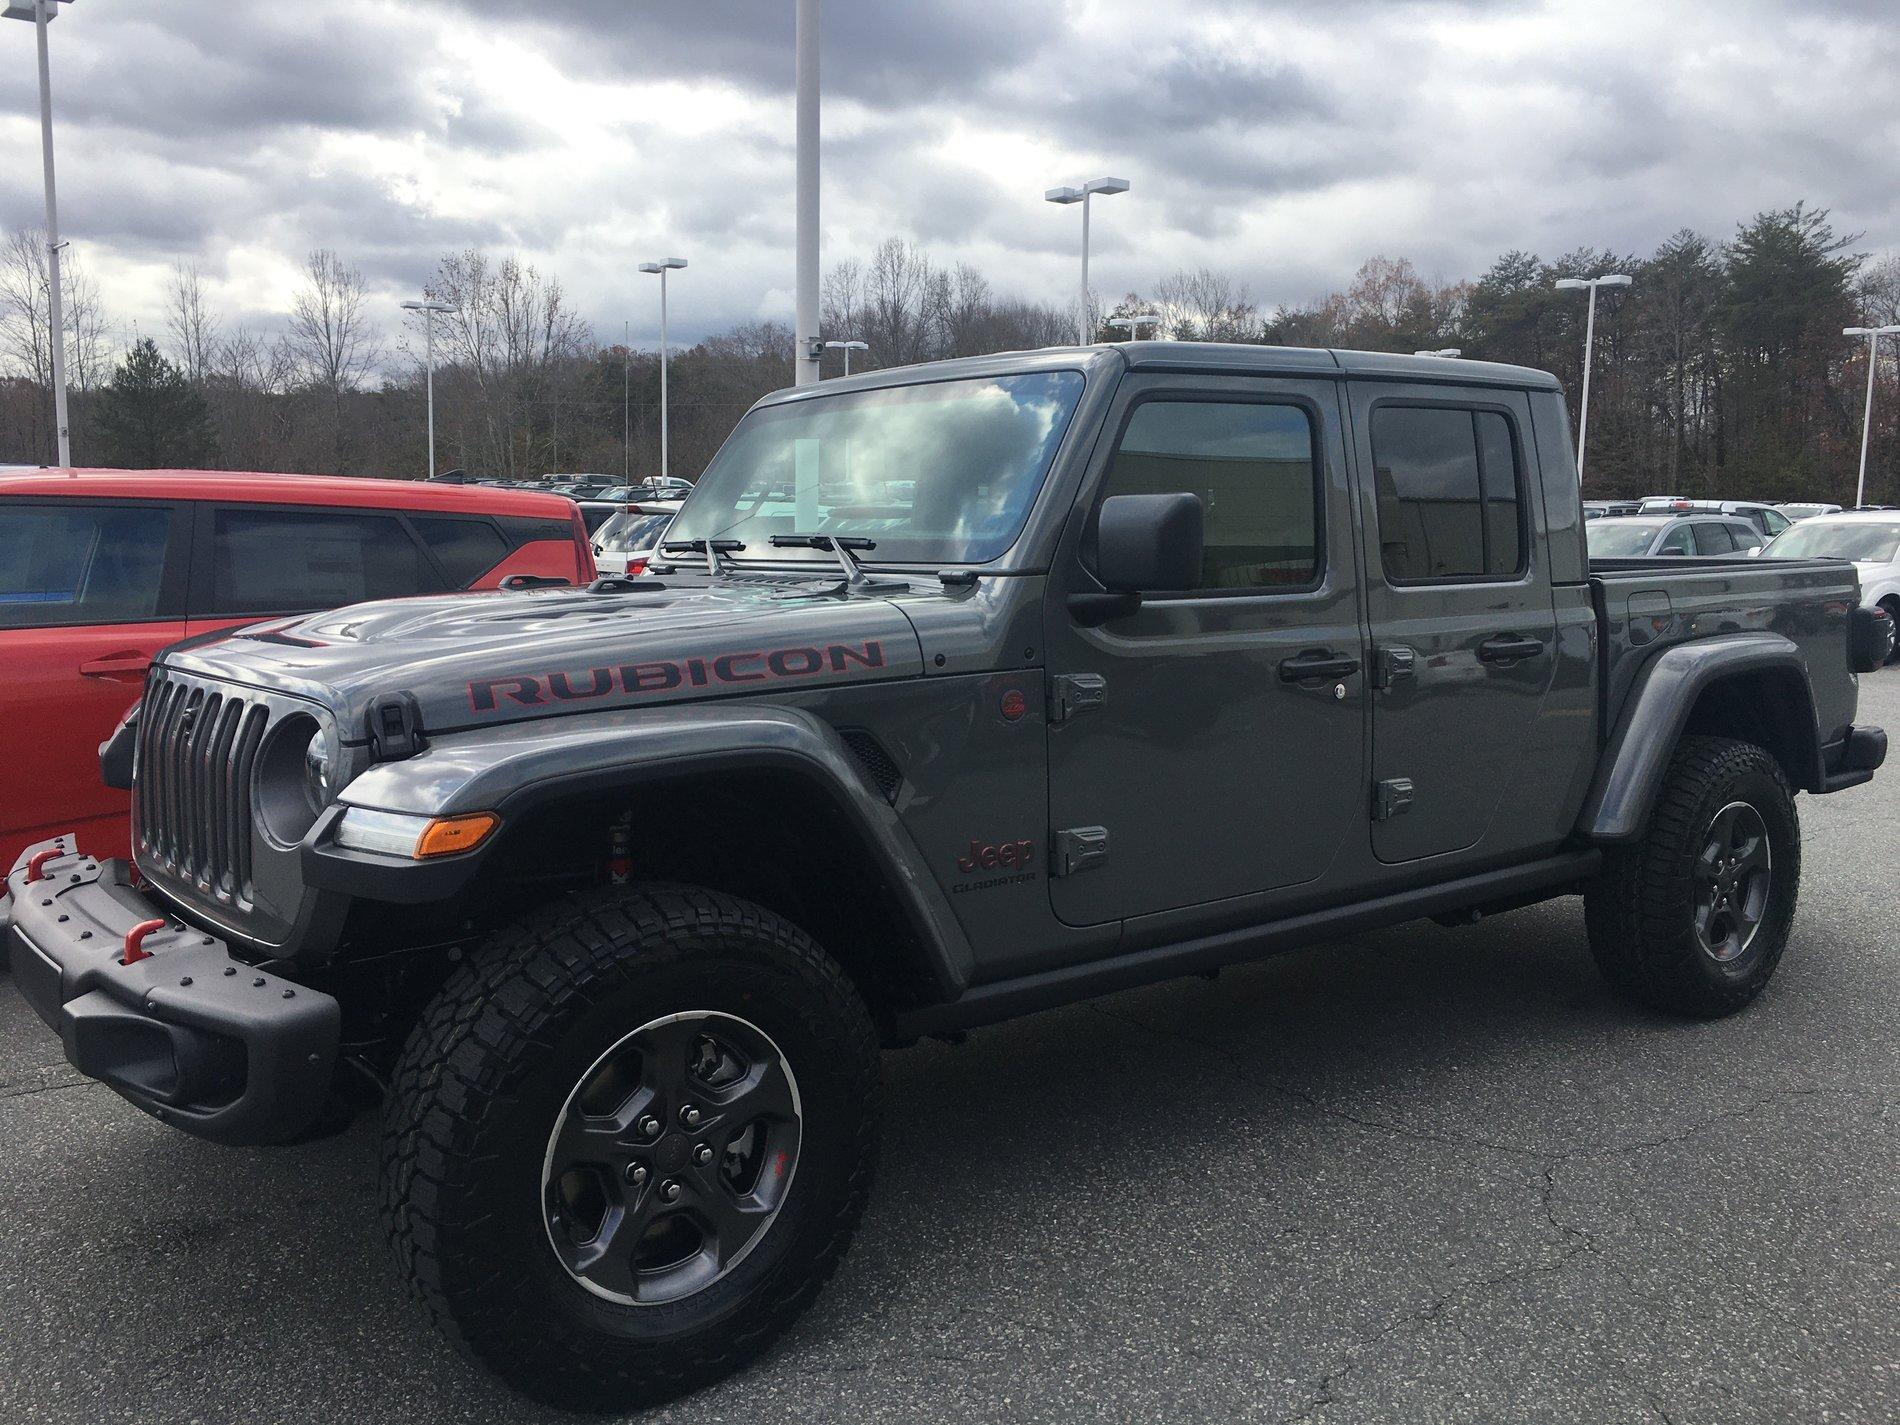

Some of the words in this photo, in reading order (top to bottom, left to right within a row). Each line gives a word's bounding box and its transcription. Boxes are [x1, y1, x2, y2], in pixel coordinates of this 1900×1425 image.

[466, 640, 886, 714] RUBICON
[957, 838, 1032, 873] Jeep
[951, 872, 1036, 894] GLADIATOR
